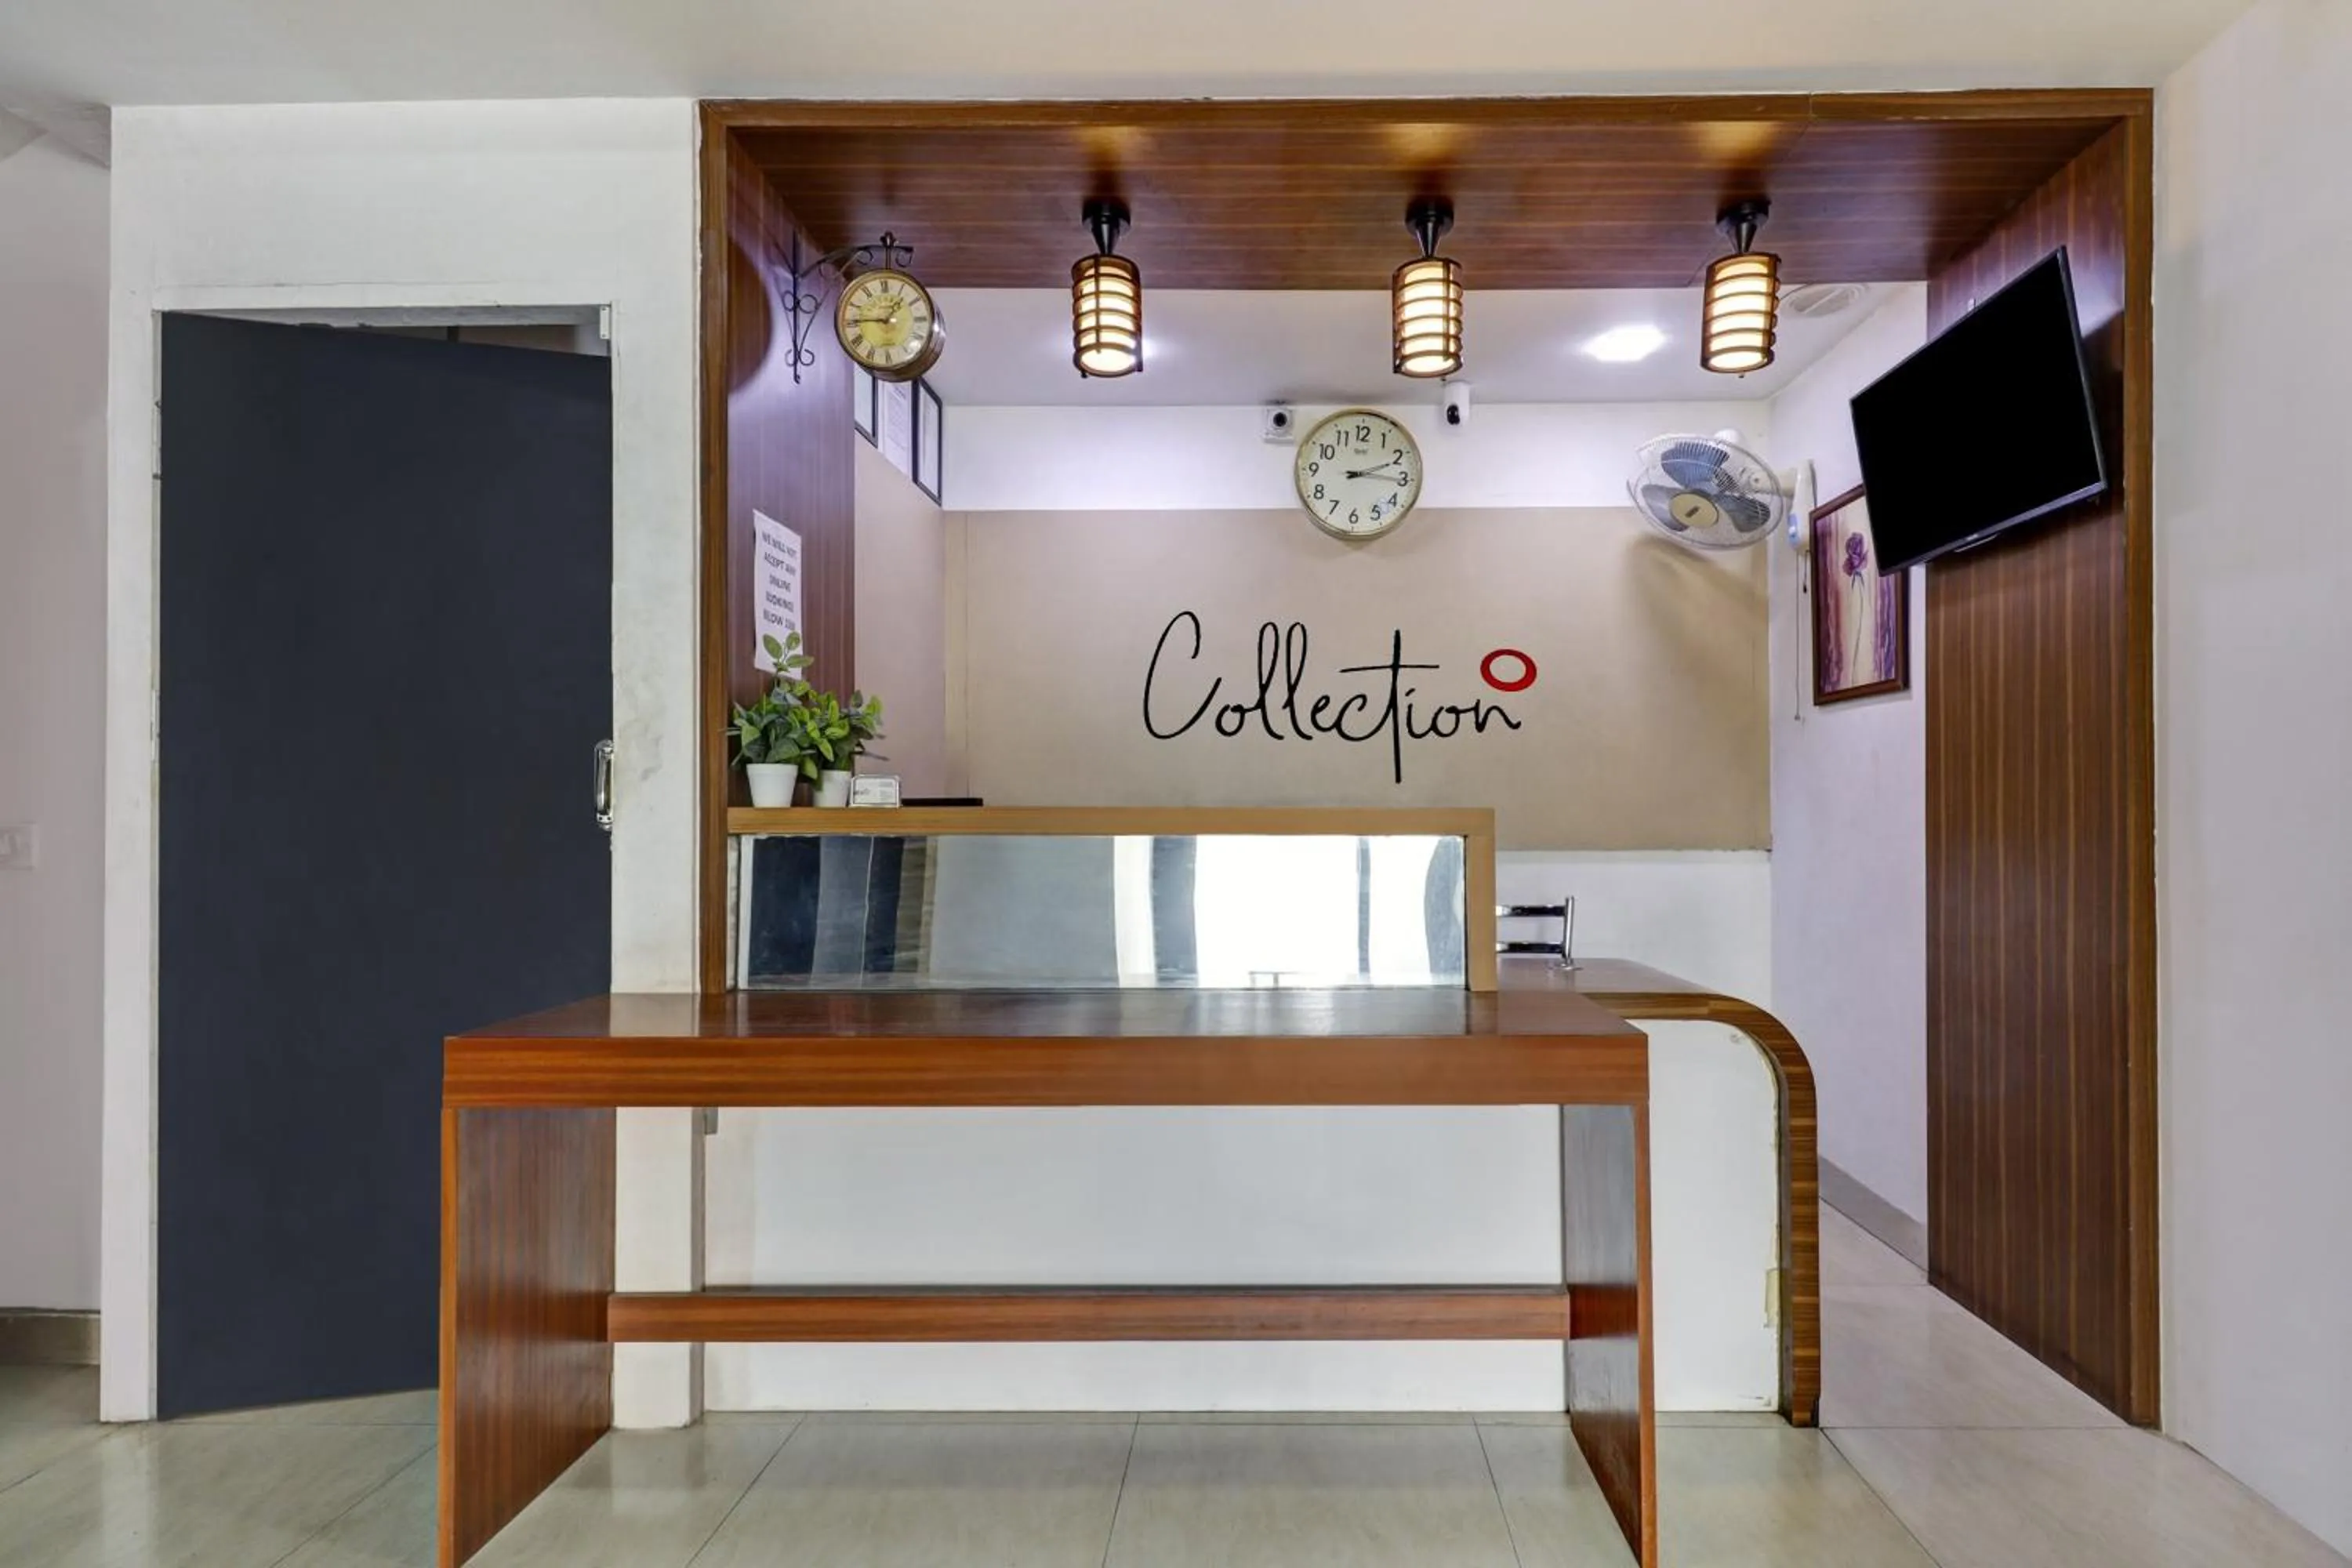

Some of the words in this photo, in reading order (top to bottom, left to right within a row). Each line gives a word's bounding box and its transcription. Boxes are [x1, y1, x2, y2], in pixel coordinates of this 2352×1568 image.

[1336, 430, 1349, 447] 11
[1356, 425, 1370, 442] 12
[1381, 433, 1386, 448] 1
[1319, 444, 1335, 460] 10
[1392, 449, 1403, 465] 2
[1308, 462, 1319, 477] 9
[1397, 471, 1409, 487] 3
[1313, 485, 1324, 499] 8
[1388, 492, 1398, 507] 4
[1329, 499, 1340, 515] 7
[1370, 505, 1381, 521] 5
[1348, 507, 1359, 524] 6
[1143, 611, 1521, 784] Collection
